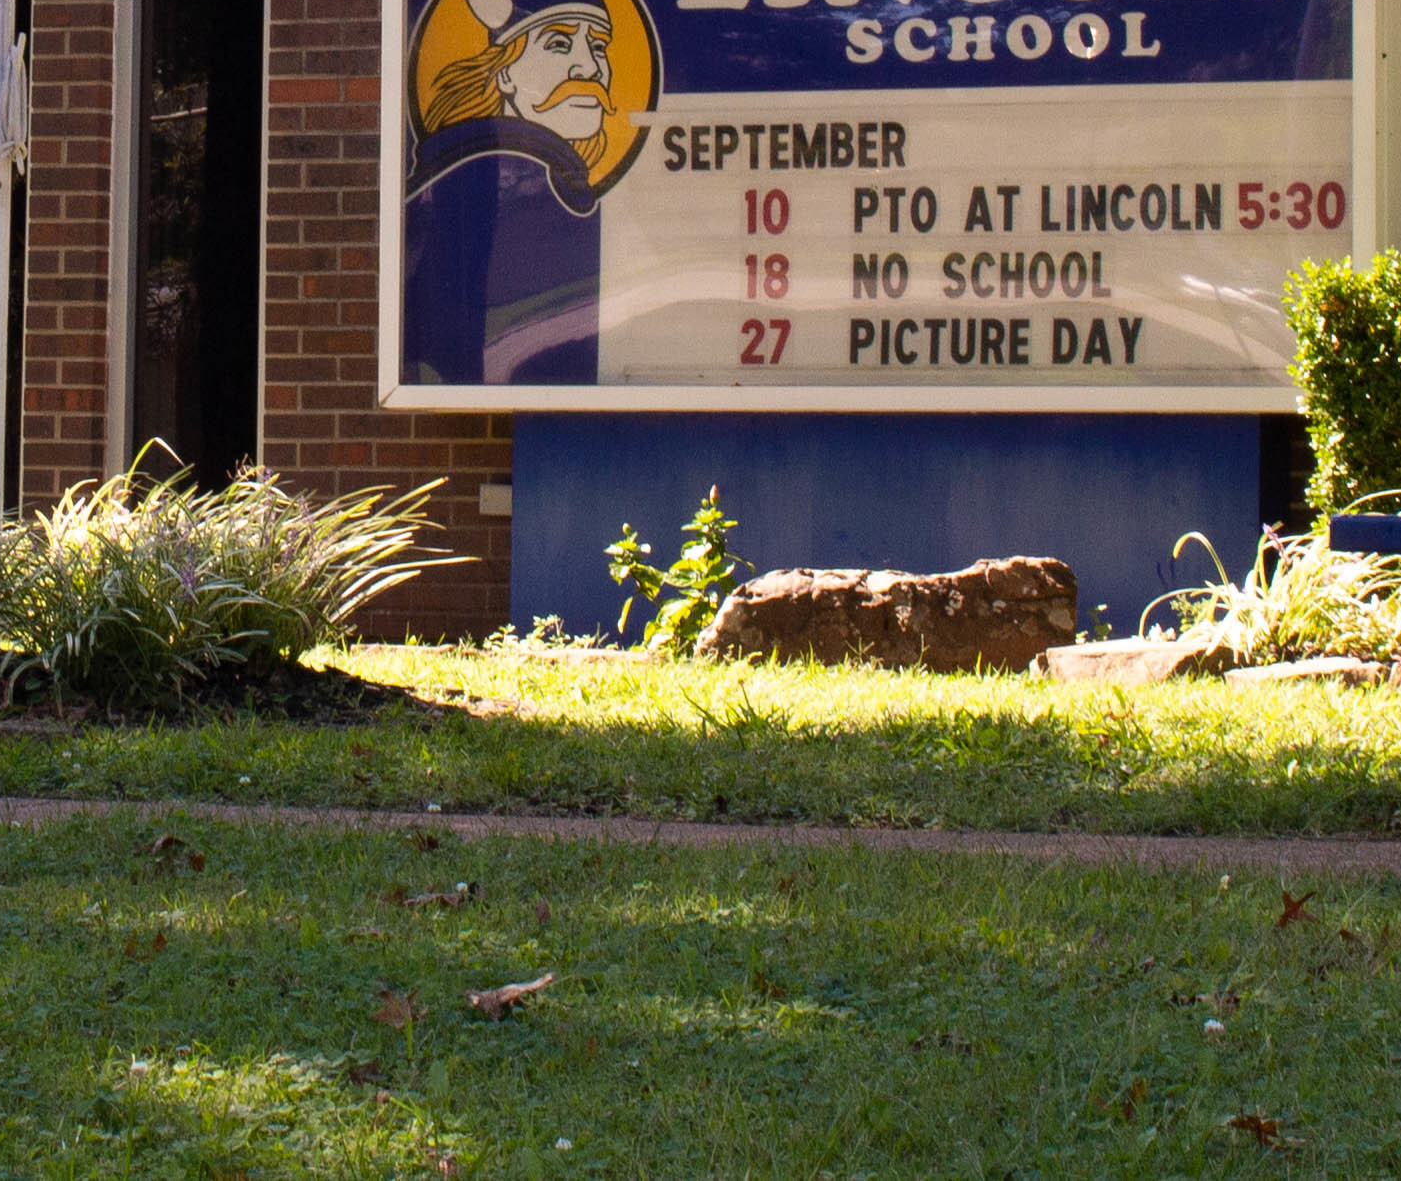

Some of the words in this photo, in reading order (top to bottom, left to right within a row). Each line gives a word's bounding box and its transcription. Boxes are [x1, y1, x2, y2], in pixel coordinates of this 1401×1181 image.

[845, 12, 1161, 66] SCHOOL
[663, 121, 906, 172] SEPTEMBER
[744, 188, 789, 234] 10
[853, 188, 937, 234] PTO
[965, 186, 1021, 234] AT
[1041, 183, 1222, 233] LINCOLN
[1237, 182, 1346, 230] 5:30
[745, 253, 789, 300] 18
[852, 253, 908, 300] NO
[942, 252, 1111, 299] SCHOOL
[740, 318, 791, 365] 27
[850, 318, 1032, 366] PICTURE
[1051, 316, 1143, 365] DAY
